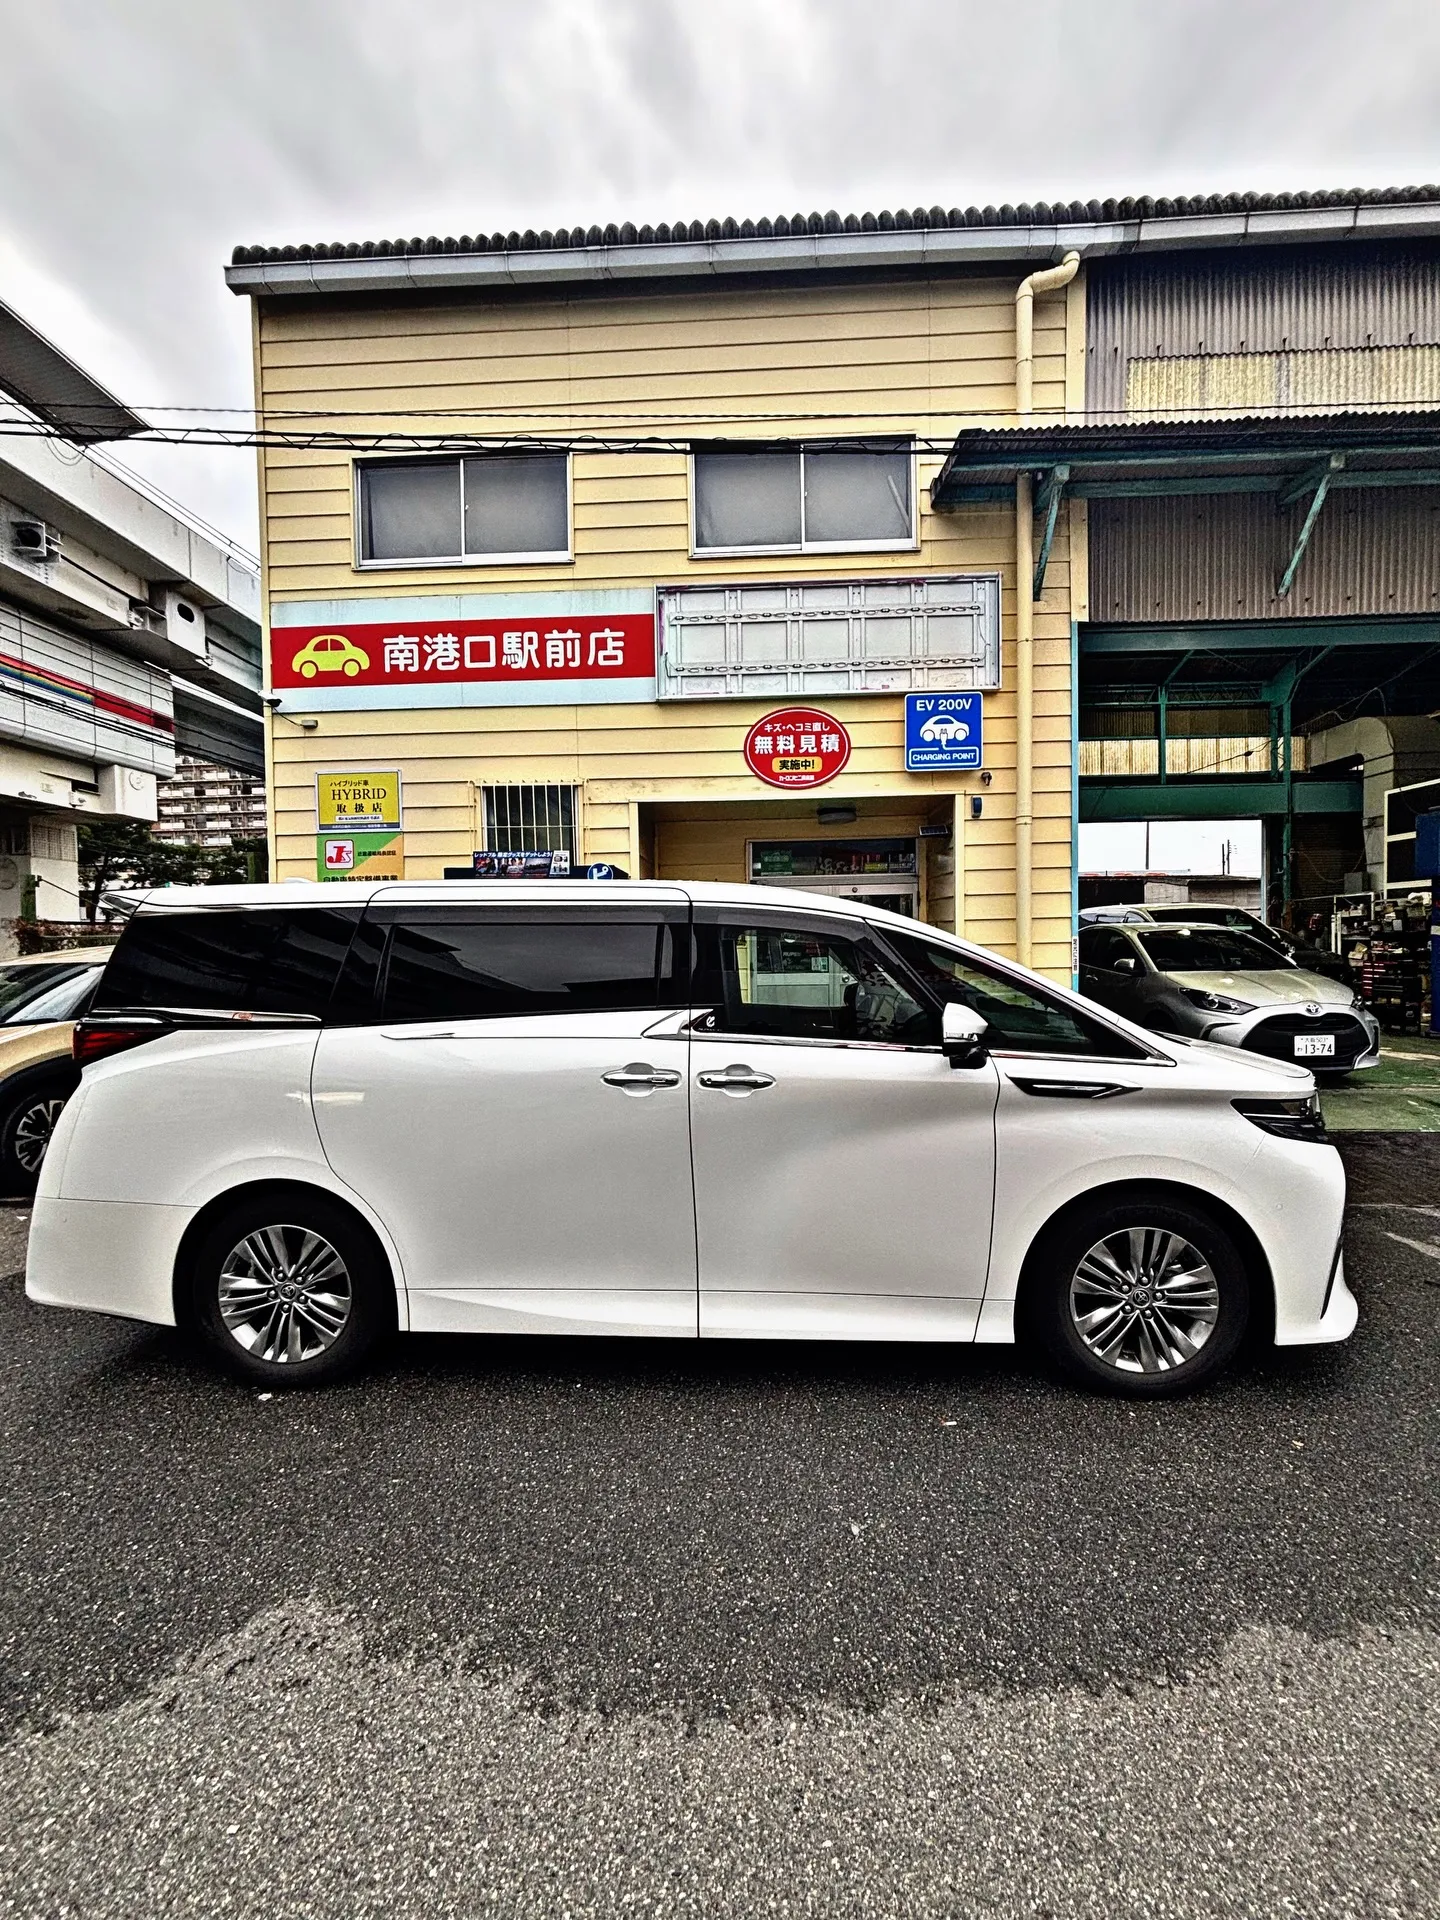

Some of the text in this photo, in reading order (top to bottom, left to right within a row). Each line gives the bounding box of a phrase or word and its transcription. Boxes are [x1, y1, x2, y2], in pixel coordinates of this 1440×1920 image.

[382, 627, 625, 673] 南港口駅前店
[916, 698, 973, 711] EV 200V
[764, 722, 831, 733] キズ・ヘコミ直し
[754, 733, 840, 755] 無料見積
[912, 752, 976, 761] CHARGING POINT
[330, 779, 370, 787] ハイブリッド車
[331, 788, 387, 801] HYBRID
[1305, 1043, 1333, 1055] 13-74
